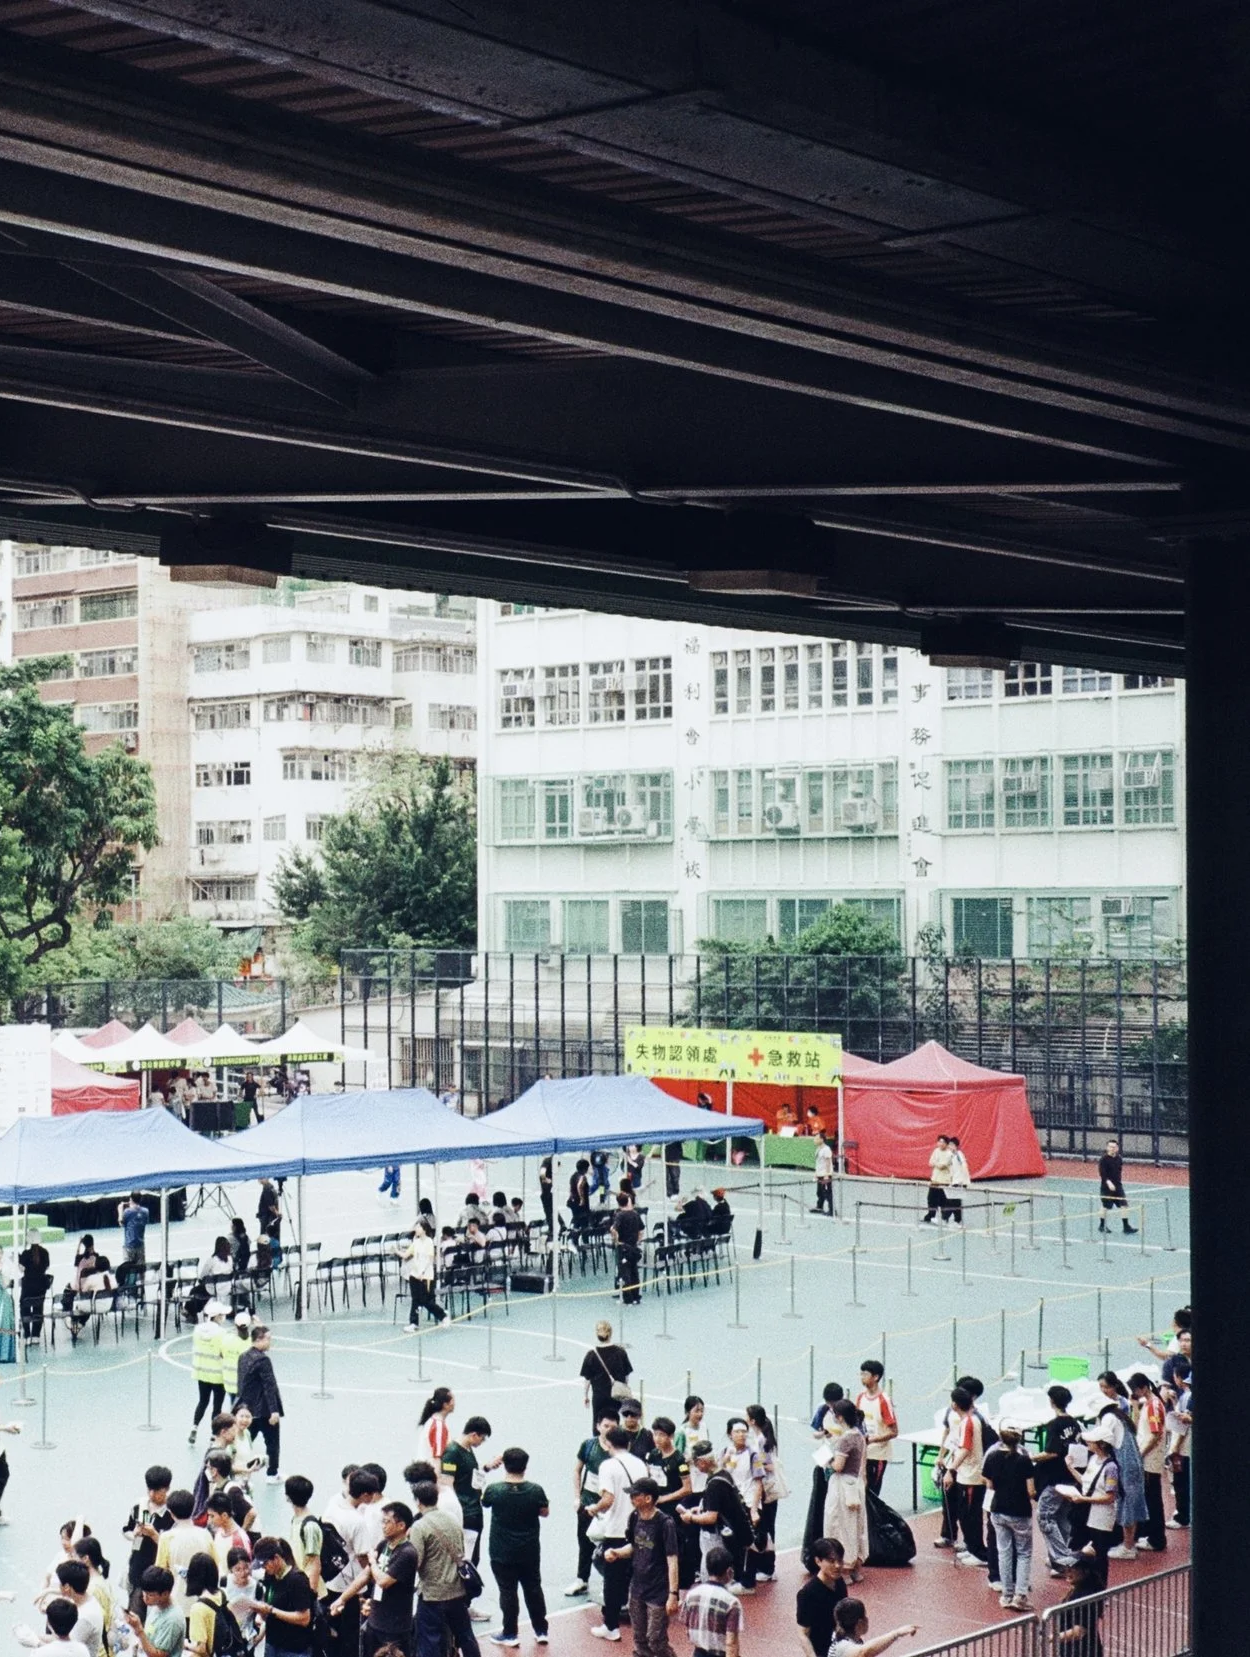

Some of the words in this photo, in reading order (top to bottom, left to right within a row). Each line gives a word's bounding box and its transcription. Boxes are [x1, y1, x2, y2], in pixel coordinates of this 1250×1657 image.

[635, 1044, 718, 1064] 失物認領處
[767, 1049, 821, 1069] 急救站
